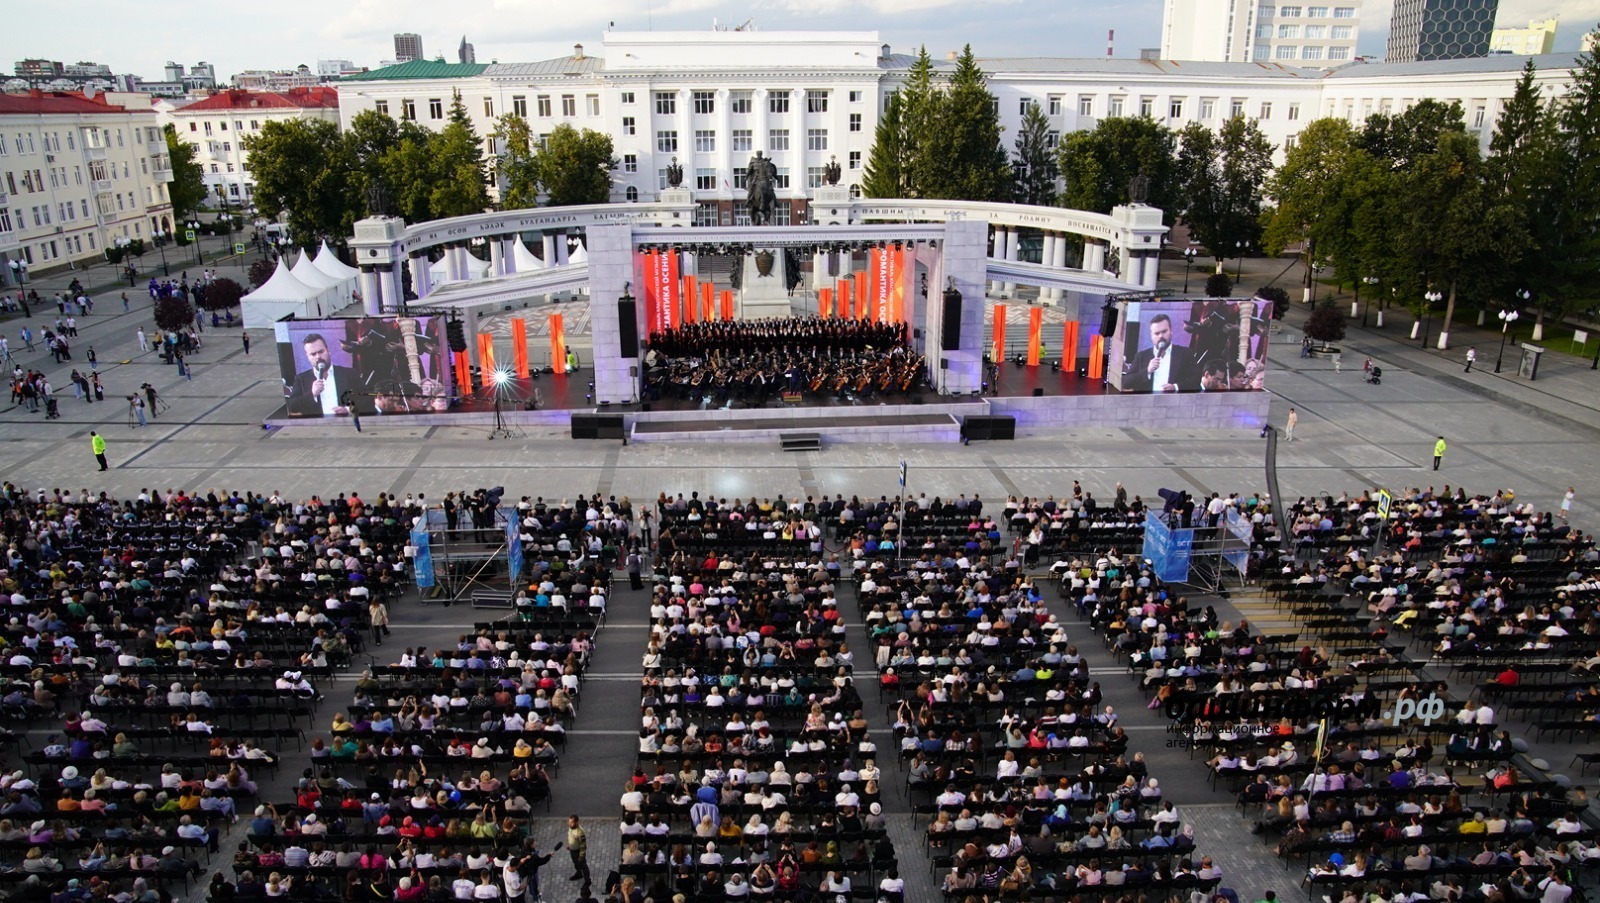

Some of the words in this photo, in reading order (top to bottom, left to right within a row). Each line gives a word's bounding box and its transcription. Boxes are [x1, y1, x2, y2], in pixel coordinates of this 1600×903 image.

[1019, 215, 1051, 223] РОДИНУ
[661, 254, 669, 284] ОСЕНИ
[879, 249, 887, 304] РОМАНТИКА
